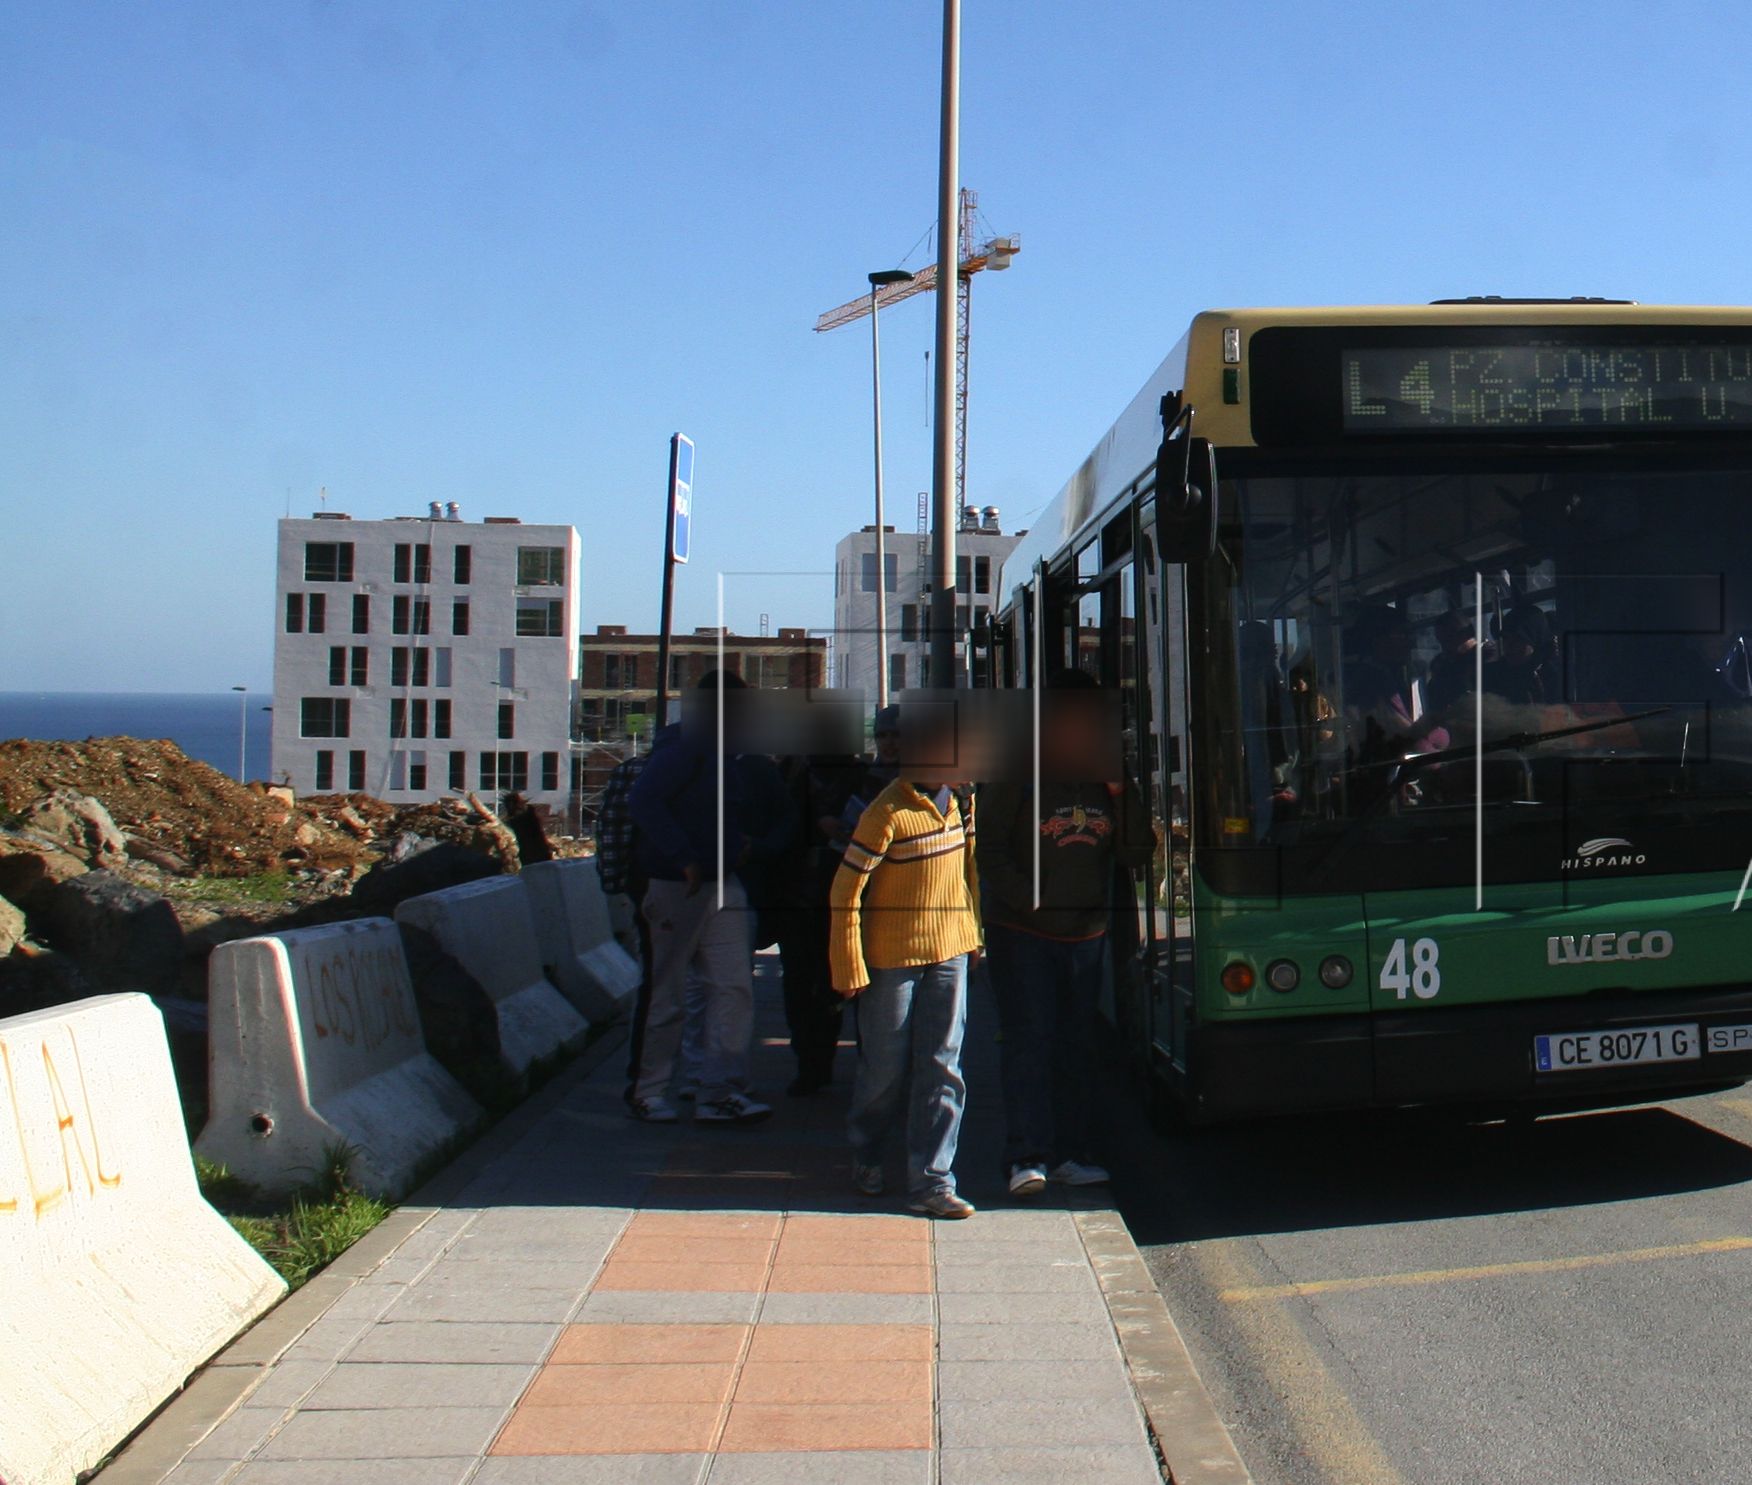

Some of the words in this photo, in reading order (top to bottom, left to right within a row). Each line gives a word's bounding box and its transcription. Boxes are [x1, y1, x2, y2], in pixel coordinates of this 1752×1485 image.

[1450, 350, 1513, 384] PZ.
[1451, 387, 1672, 423] HOSPITAL
[1560, 854, 1646, 870] HISPANO
[1547, 930, 1674, 966] IVECO
[1379, 937, 1441, 1000] 48
[1558, 1036, 1593, 1065] CE
[1599, 1031, 1662, 1061] 8071
[1671, 1029, 1688, 1056] G
